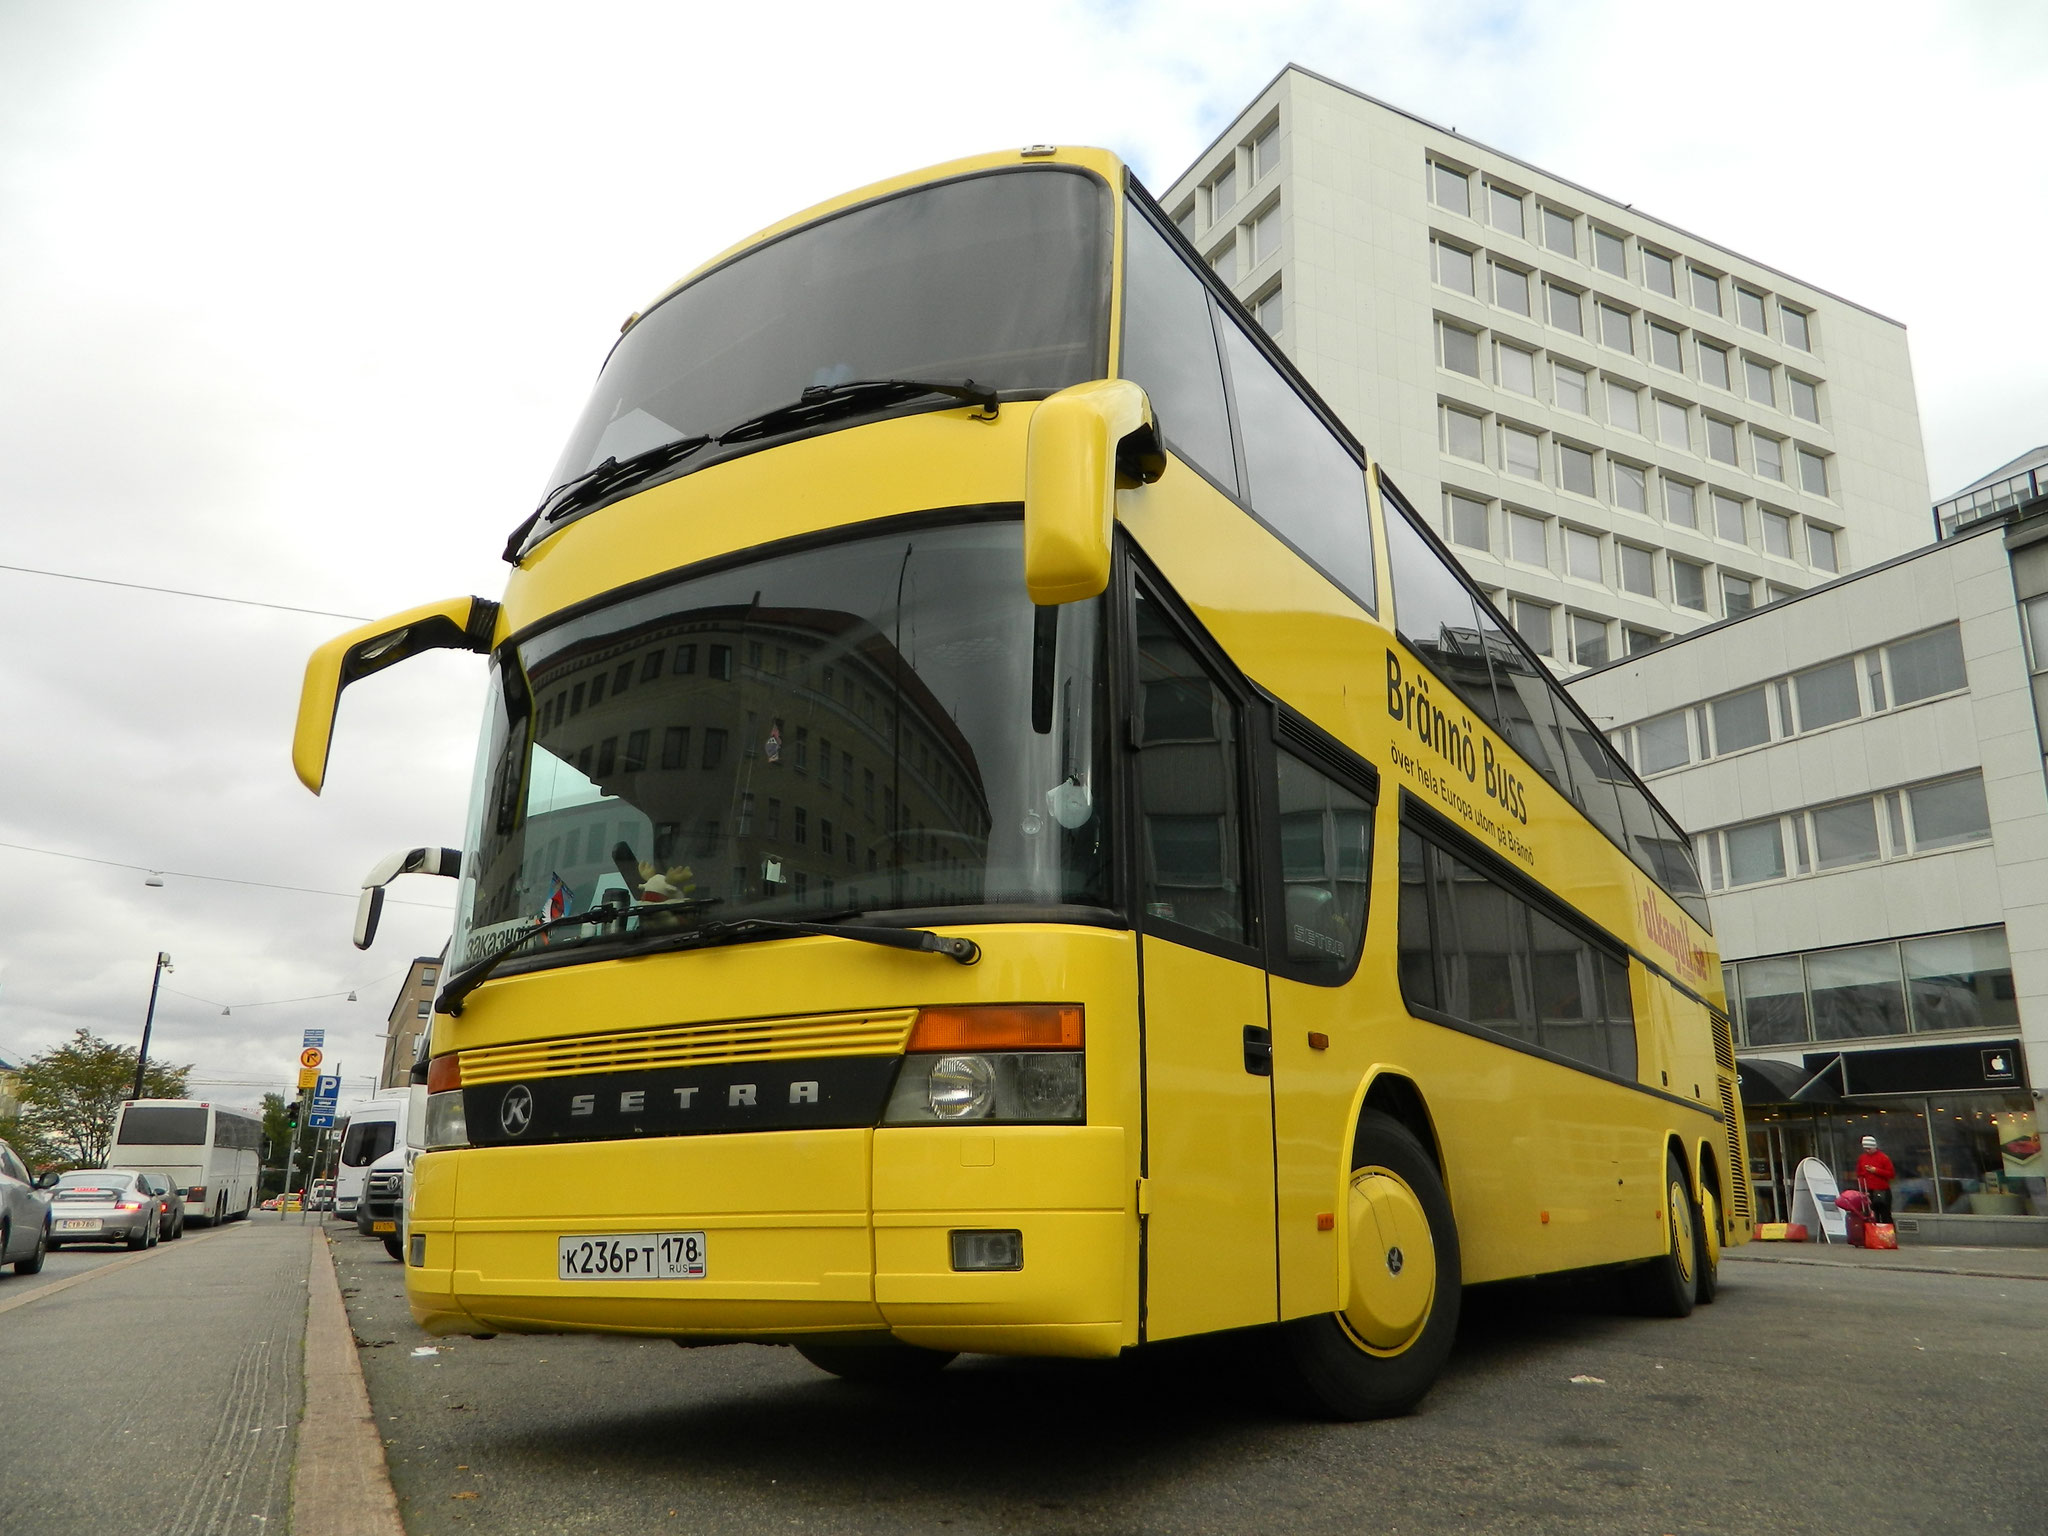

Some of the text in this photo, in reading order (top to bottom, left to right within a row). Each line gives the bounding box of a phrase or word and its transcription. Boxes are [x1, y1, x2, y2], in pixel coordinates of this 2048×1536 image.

[1385, 647, 1528, 825] Brännö Buss
[1390, 738, 1535, 867] över hela Europa utom på Brännö
[1293, 923, 1345, 958] SETRA
[319, 1076, 338, 1097] P
[571, 1080, 819, 1116] SETRA
[660, 1236, 698, 1263] 178
[669, 1264, 688, 1273] RUS
